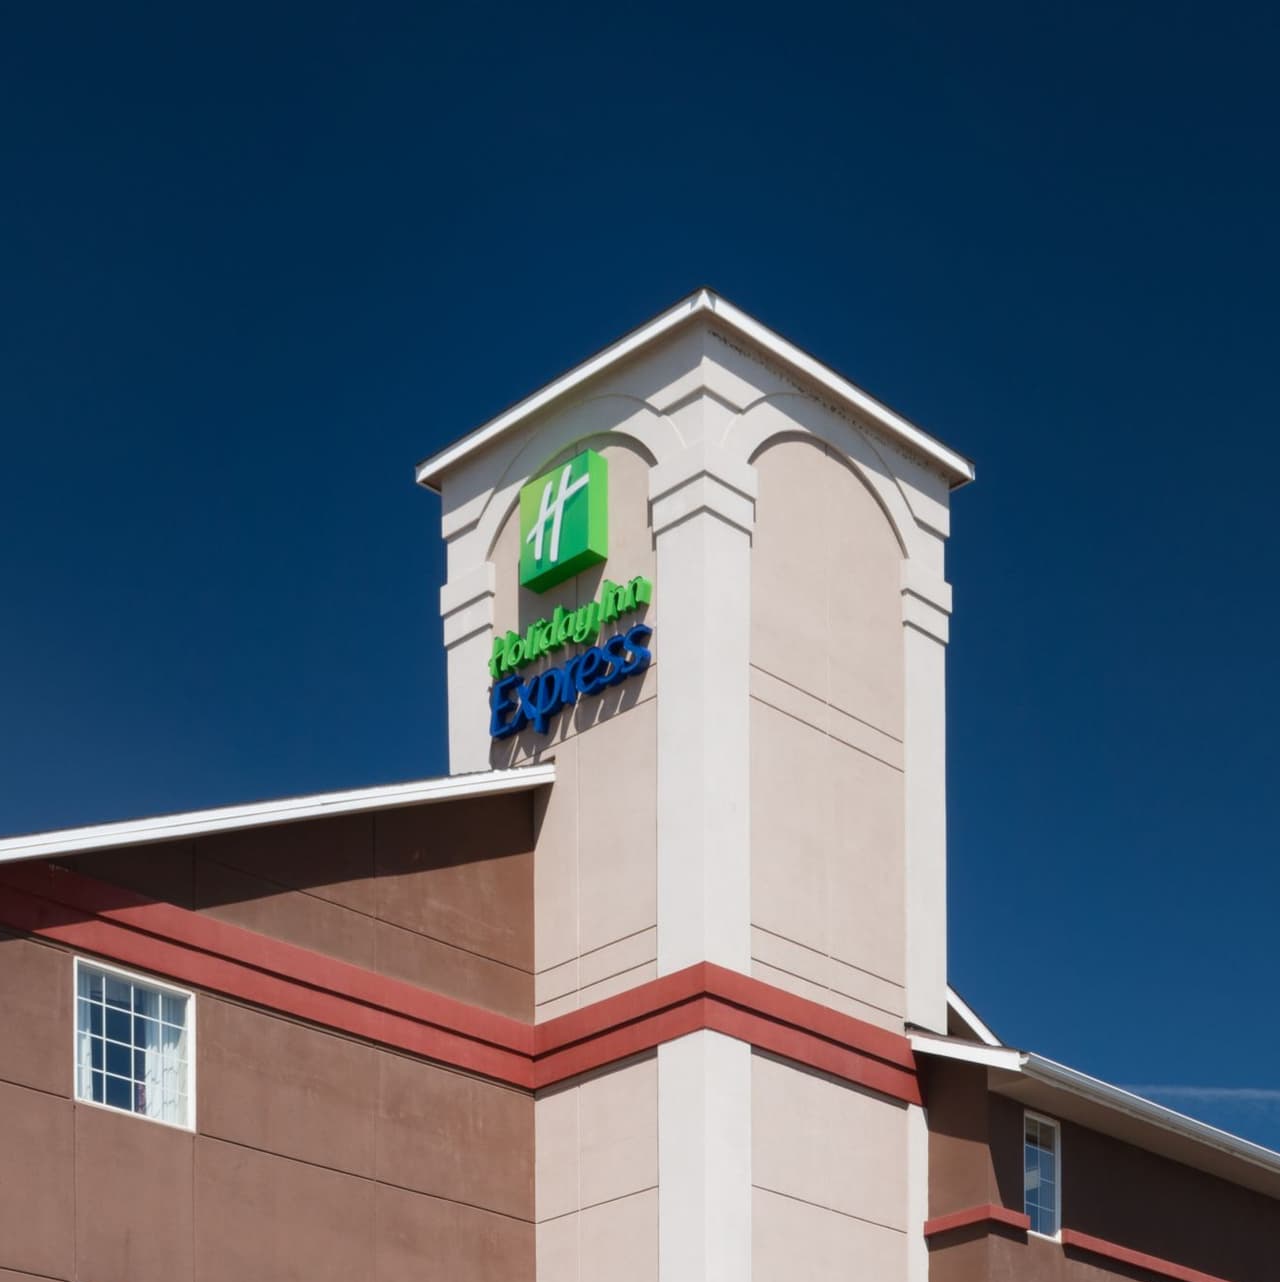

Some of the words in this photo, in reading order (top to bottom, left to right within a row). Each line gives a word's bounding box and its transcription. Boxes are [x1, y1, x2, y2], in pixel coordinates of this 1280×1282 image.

[488, 603, 600, 679] Holiday
[597, 576, 652, 624] Inn
[489, 623, 653, 739] Express
